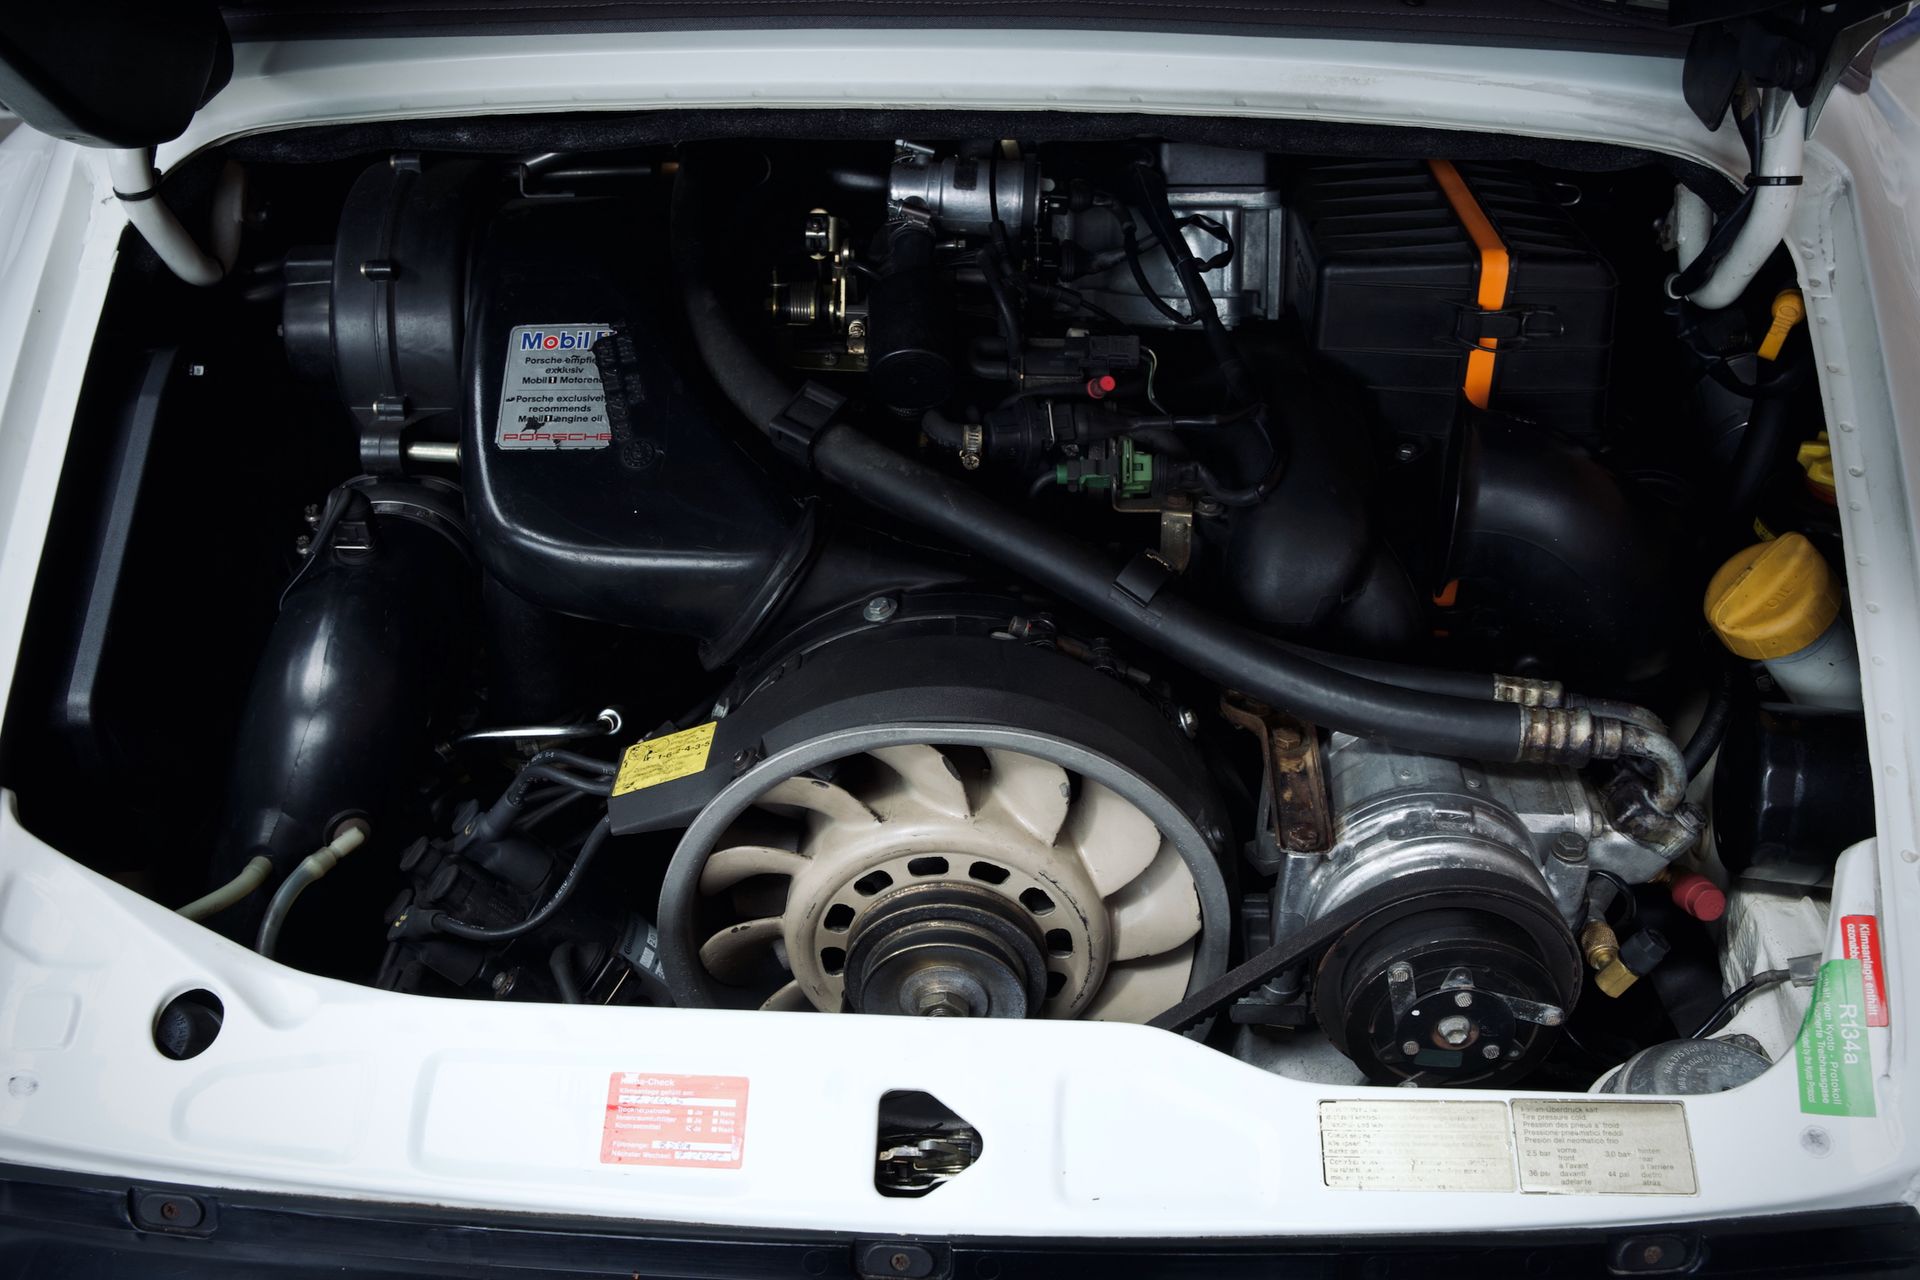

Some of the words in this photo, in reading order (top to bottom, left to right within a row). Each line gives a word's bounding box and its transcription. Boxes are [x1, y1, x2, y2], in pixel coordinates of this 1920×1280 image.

[521, 331, 591, 350] Mobil
[525, 356, 563, 365] Porsche
[522, 376, 547, 385] Mobil
[516, 395, 554, 403] Porsche
[519, 415, 543, 423] Mobil
[555, 415, 588, 424] engine
[1859, 923, 1874, 979] Klimaanlage
[1866, 980, 1879, 1015] enthält
[1824, 1001, 1833, 1021] vom
[1823, 1023, 1836, 1052] Kyoto
[1839, 1003, 1859, 1065] R134a
[1817, 1040, 1830, 1104] Treibhausgase
[1829, 1061, 1842, 1105] Protokoll
[1537, 1114, 1569, 1122] pressure
[1555, 1121, 1569, 1129] des
[1570, 1122, 1592, 1130] pneus
